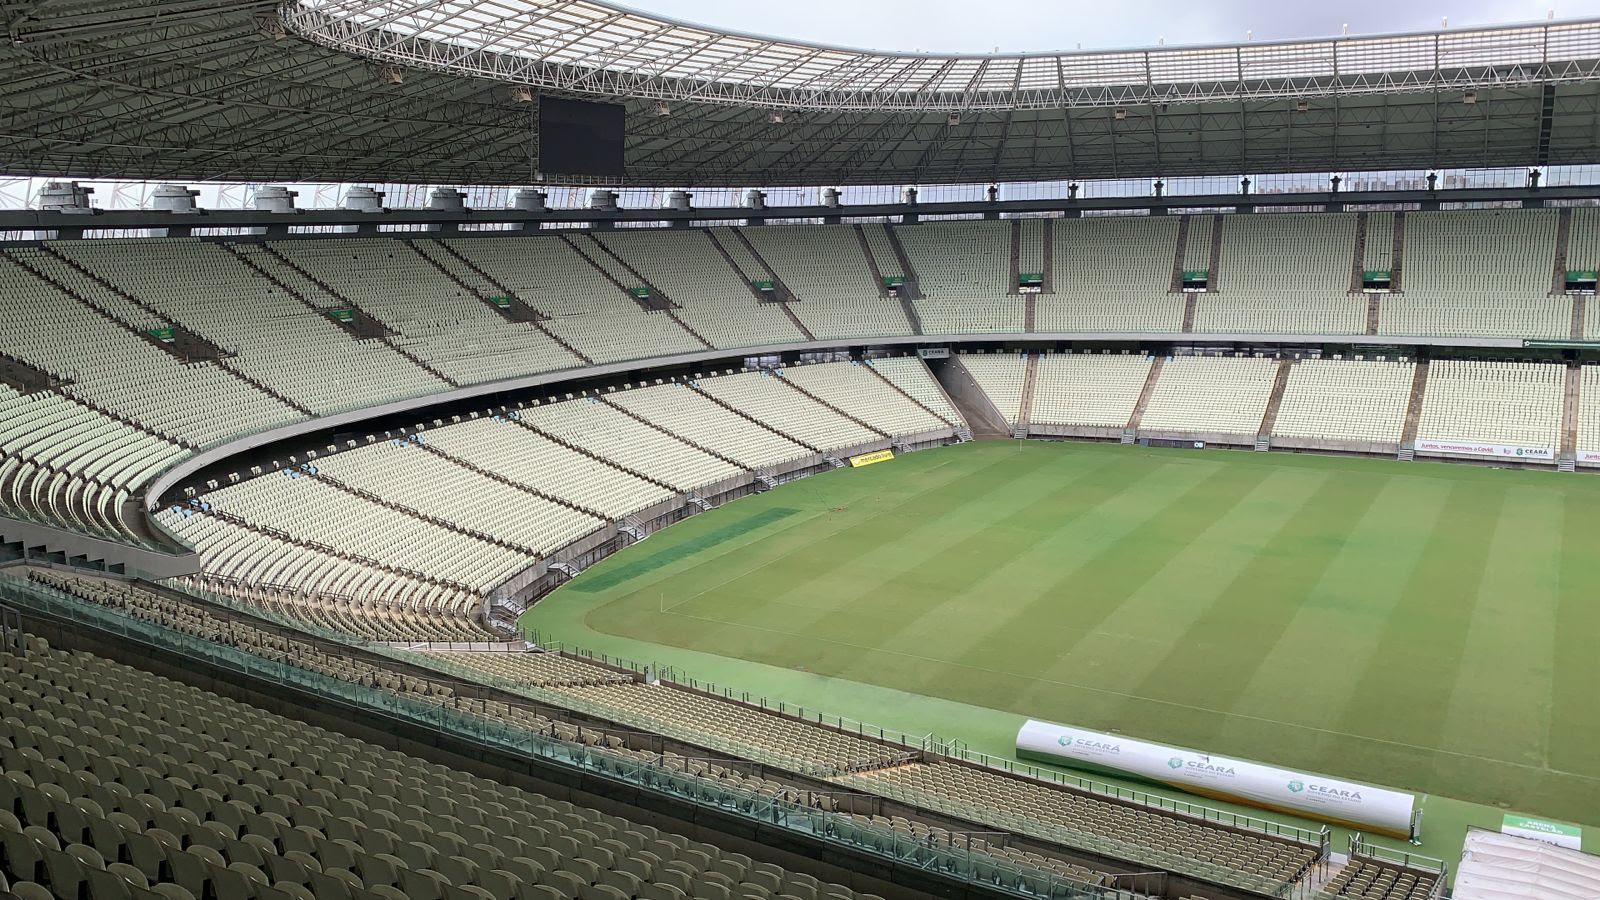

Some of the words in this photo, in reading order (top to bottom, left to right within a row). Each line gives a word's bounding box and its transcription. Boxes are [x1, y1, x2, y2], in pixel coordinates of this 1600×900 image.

[1076, 737, 1120, 752] CEARÁ
[1187, 761, 1235, 774] CEARÁ
[1308, 784, 1362, 799] CEARÁ
